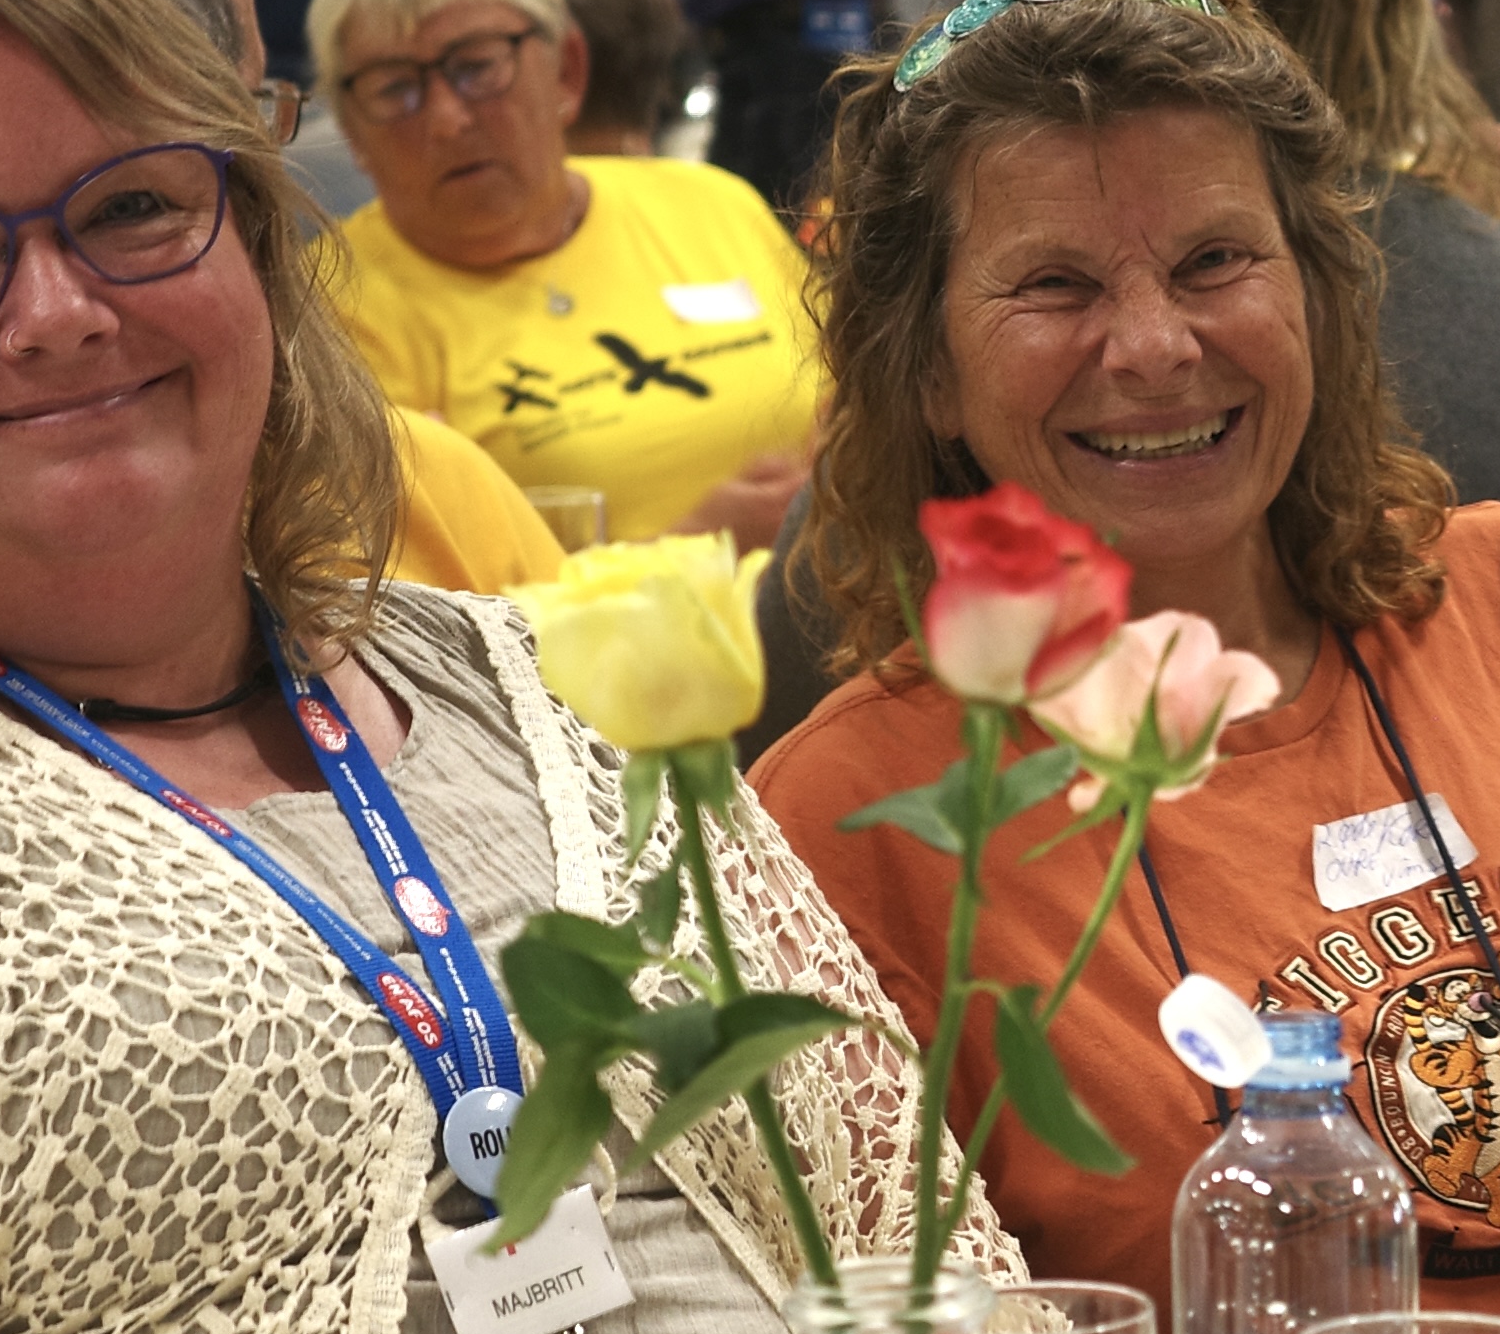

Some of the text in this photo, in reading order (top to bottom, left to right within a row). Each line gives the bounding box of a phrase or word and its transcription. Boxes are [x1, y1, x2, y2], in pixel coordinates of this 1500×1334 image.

[380, 974, 440, 1046] EN AF OS
[491, 1265, 590, 1320] MAJBRITT
